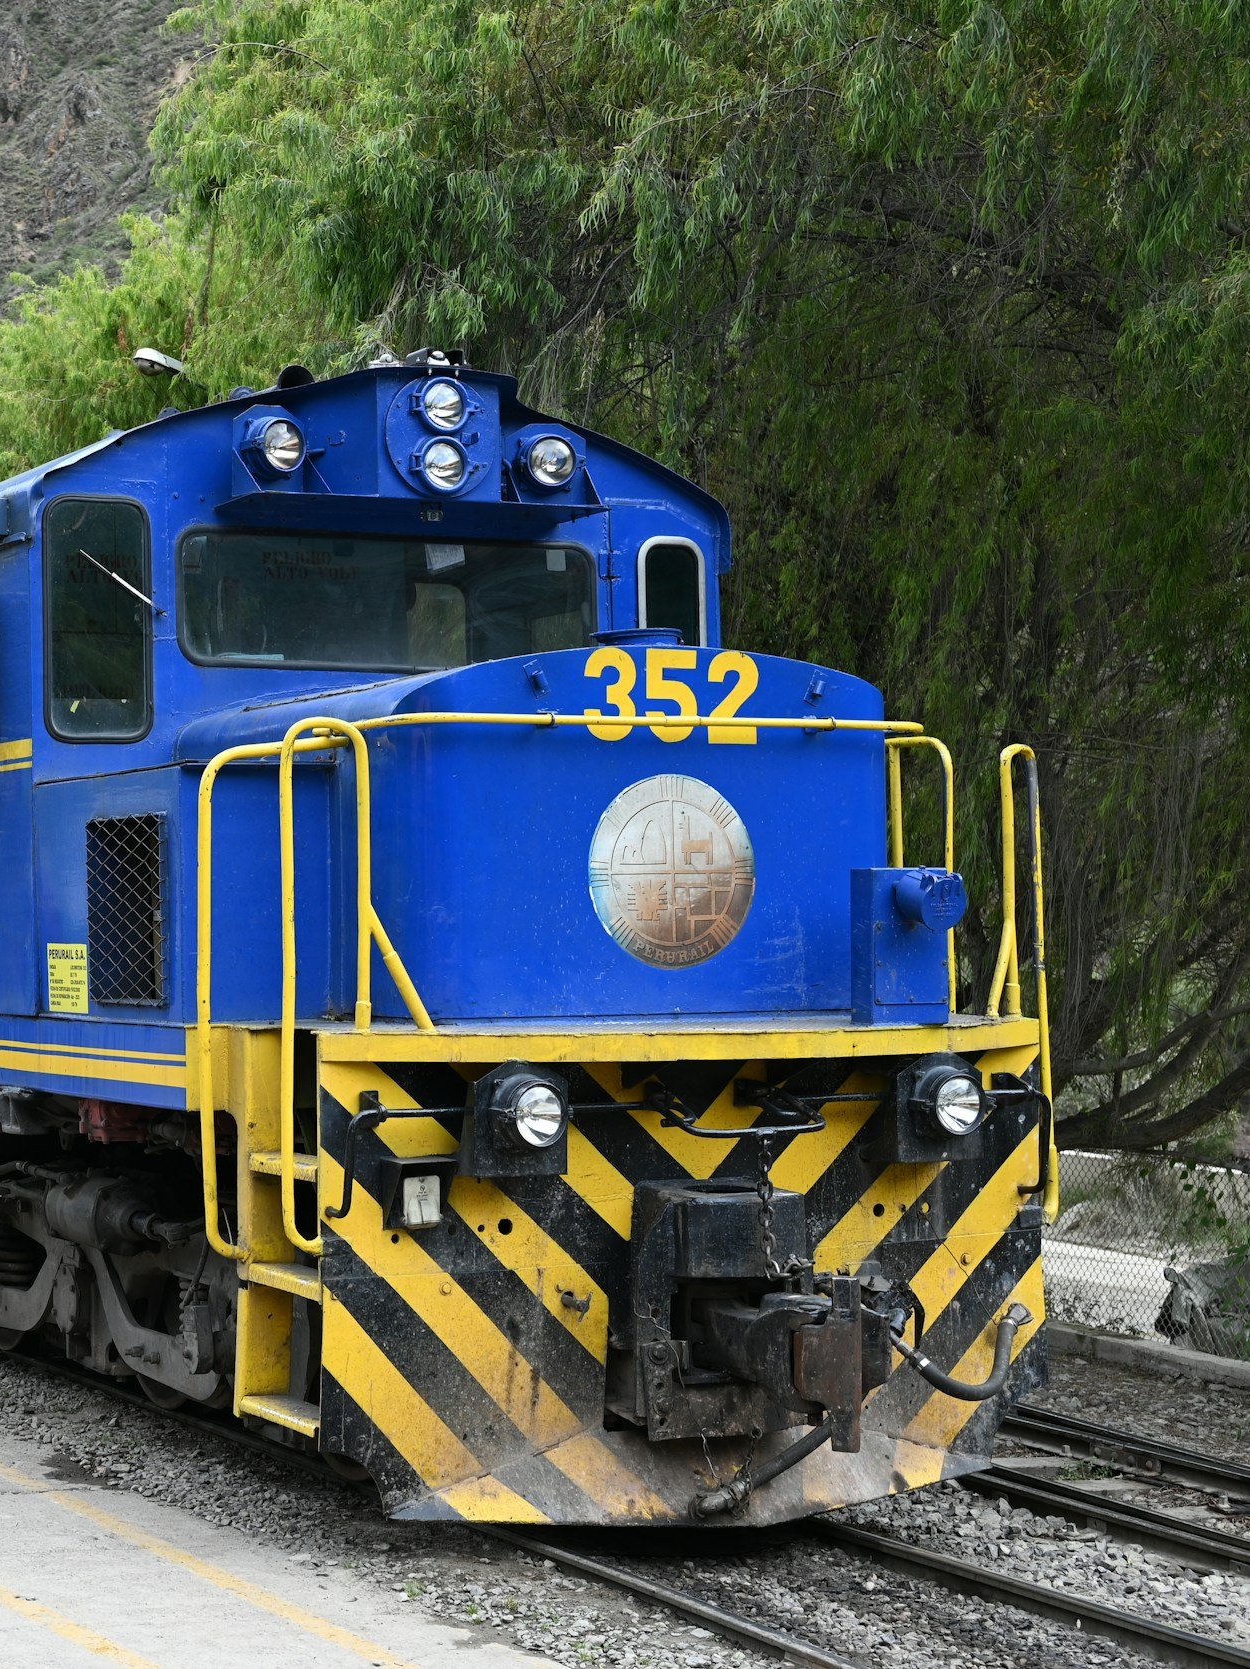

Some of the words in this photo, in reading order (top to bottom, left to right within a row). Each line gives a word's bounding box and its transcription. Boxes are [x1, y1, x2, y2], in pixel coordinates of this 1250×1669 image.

[584, 647, 759, 744] 352
[49, 949, 74, 960] PERURAIL
[75, 949, 86, 960] S.A.
[632, 939, 714, 963] PERURAIL
